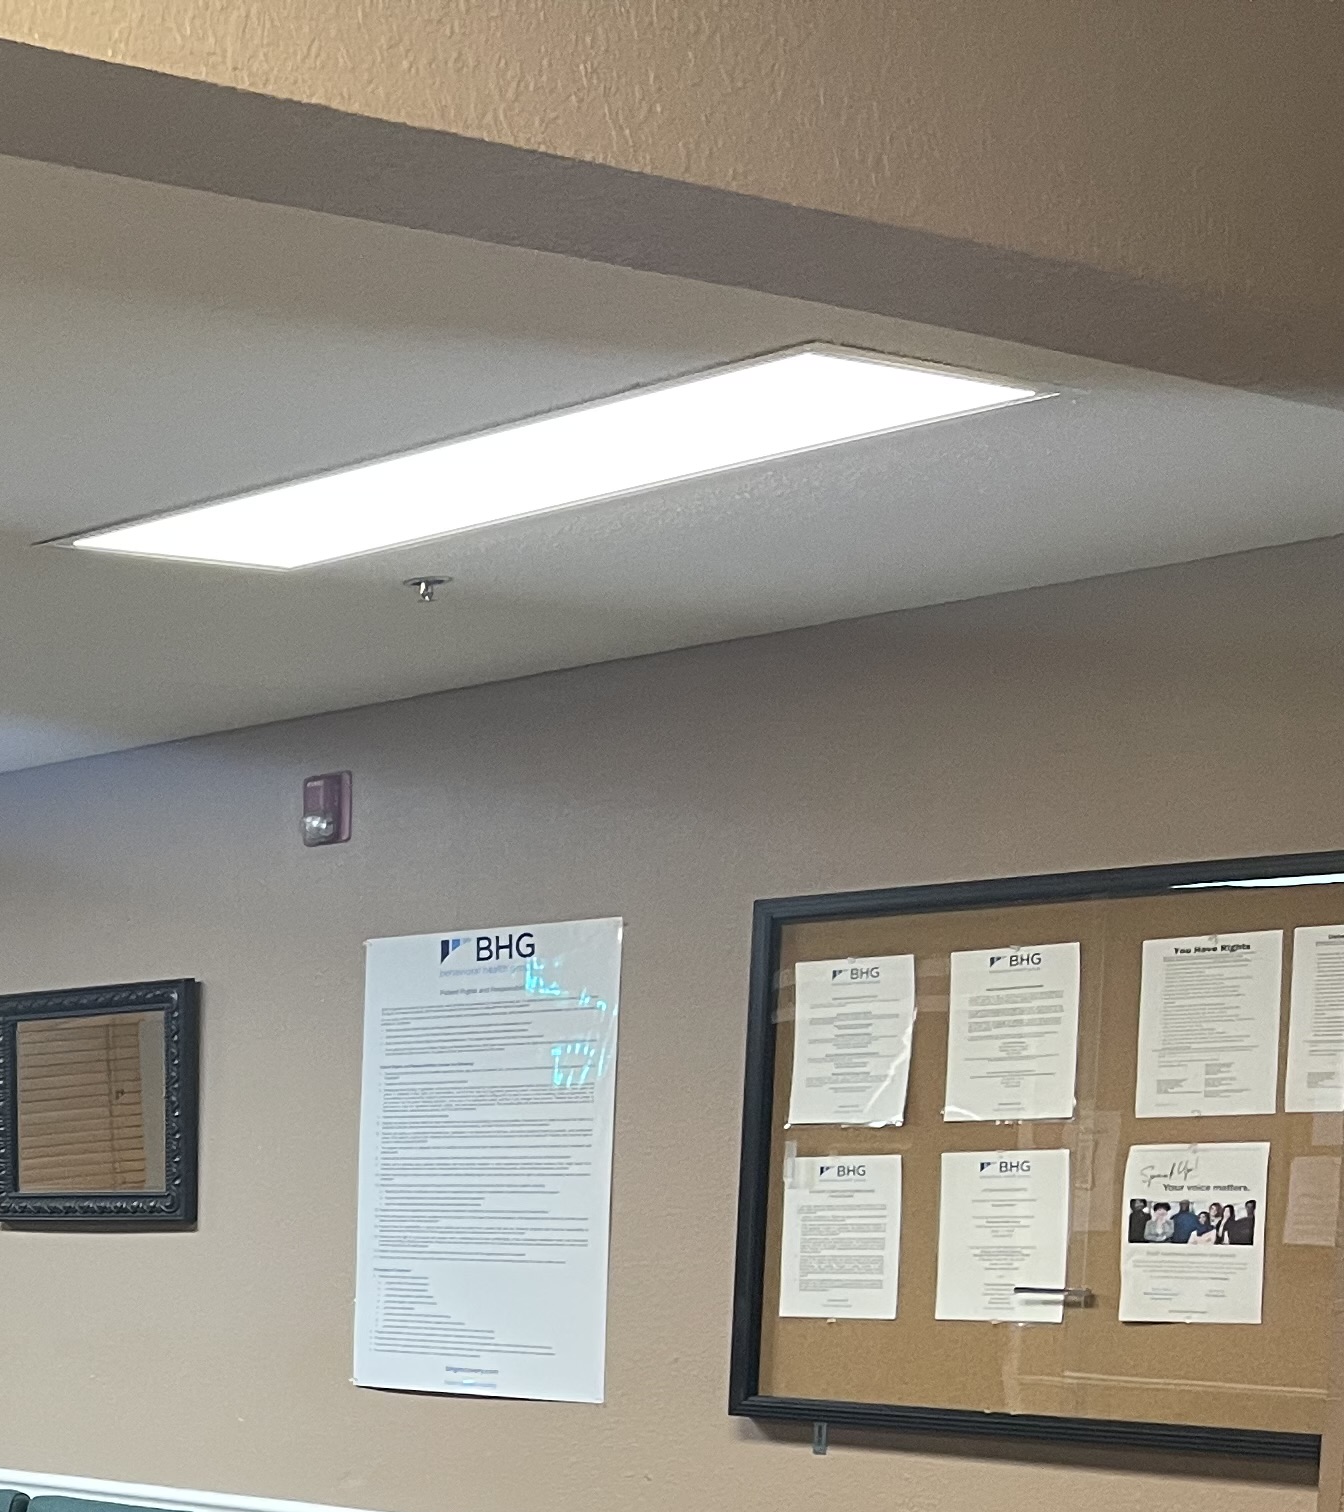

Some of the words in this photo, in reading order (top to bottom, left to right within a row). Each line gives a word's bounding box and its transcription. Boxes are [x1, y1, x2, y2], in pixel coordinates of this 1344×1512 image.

[476, 932, 535, 961] BHG
[1220, 943, 1251, 952] Rights
[1009, 952, 1042, 967] BHG
[849, 966, 880, 980] BHG
[836, 1165, 866, 1177] BHG
[999, 1160, 1031, 1173] BHG
[1213, 1184, 1251, 1192] matters.
